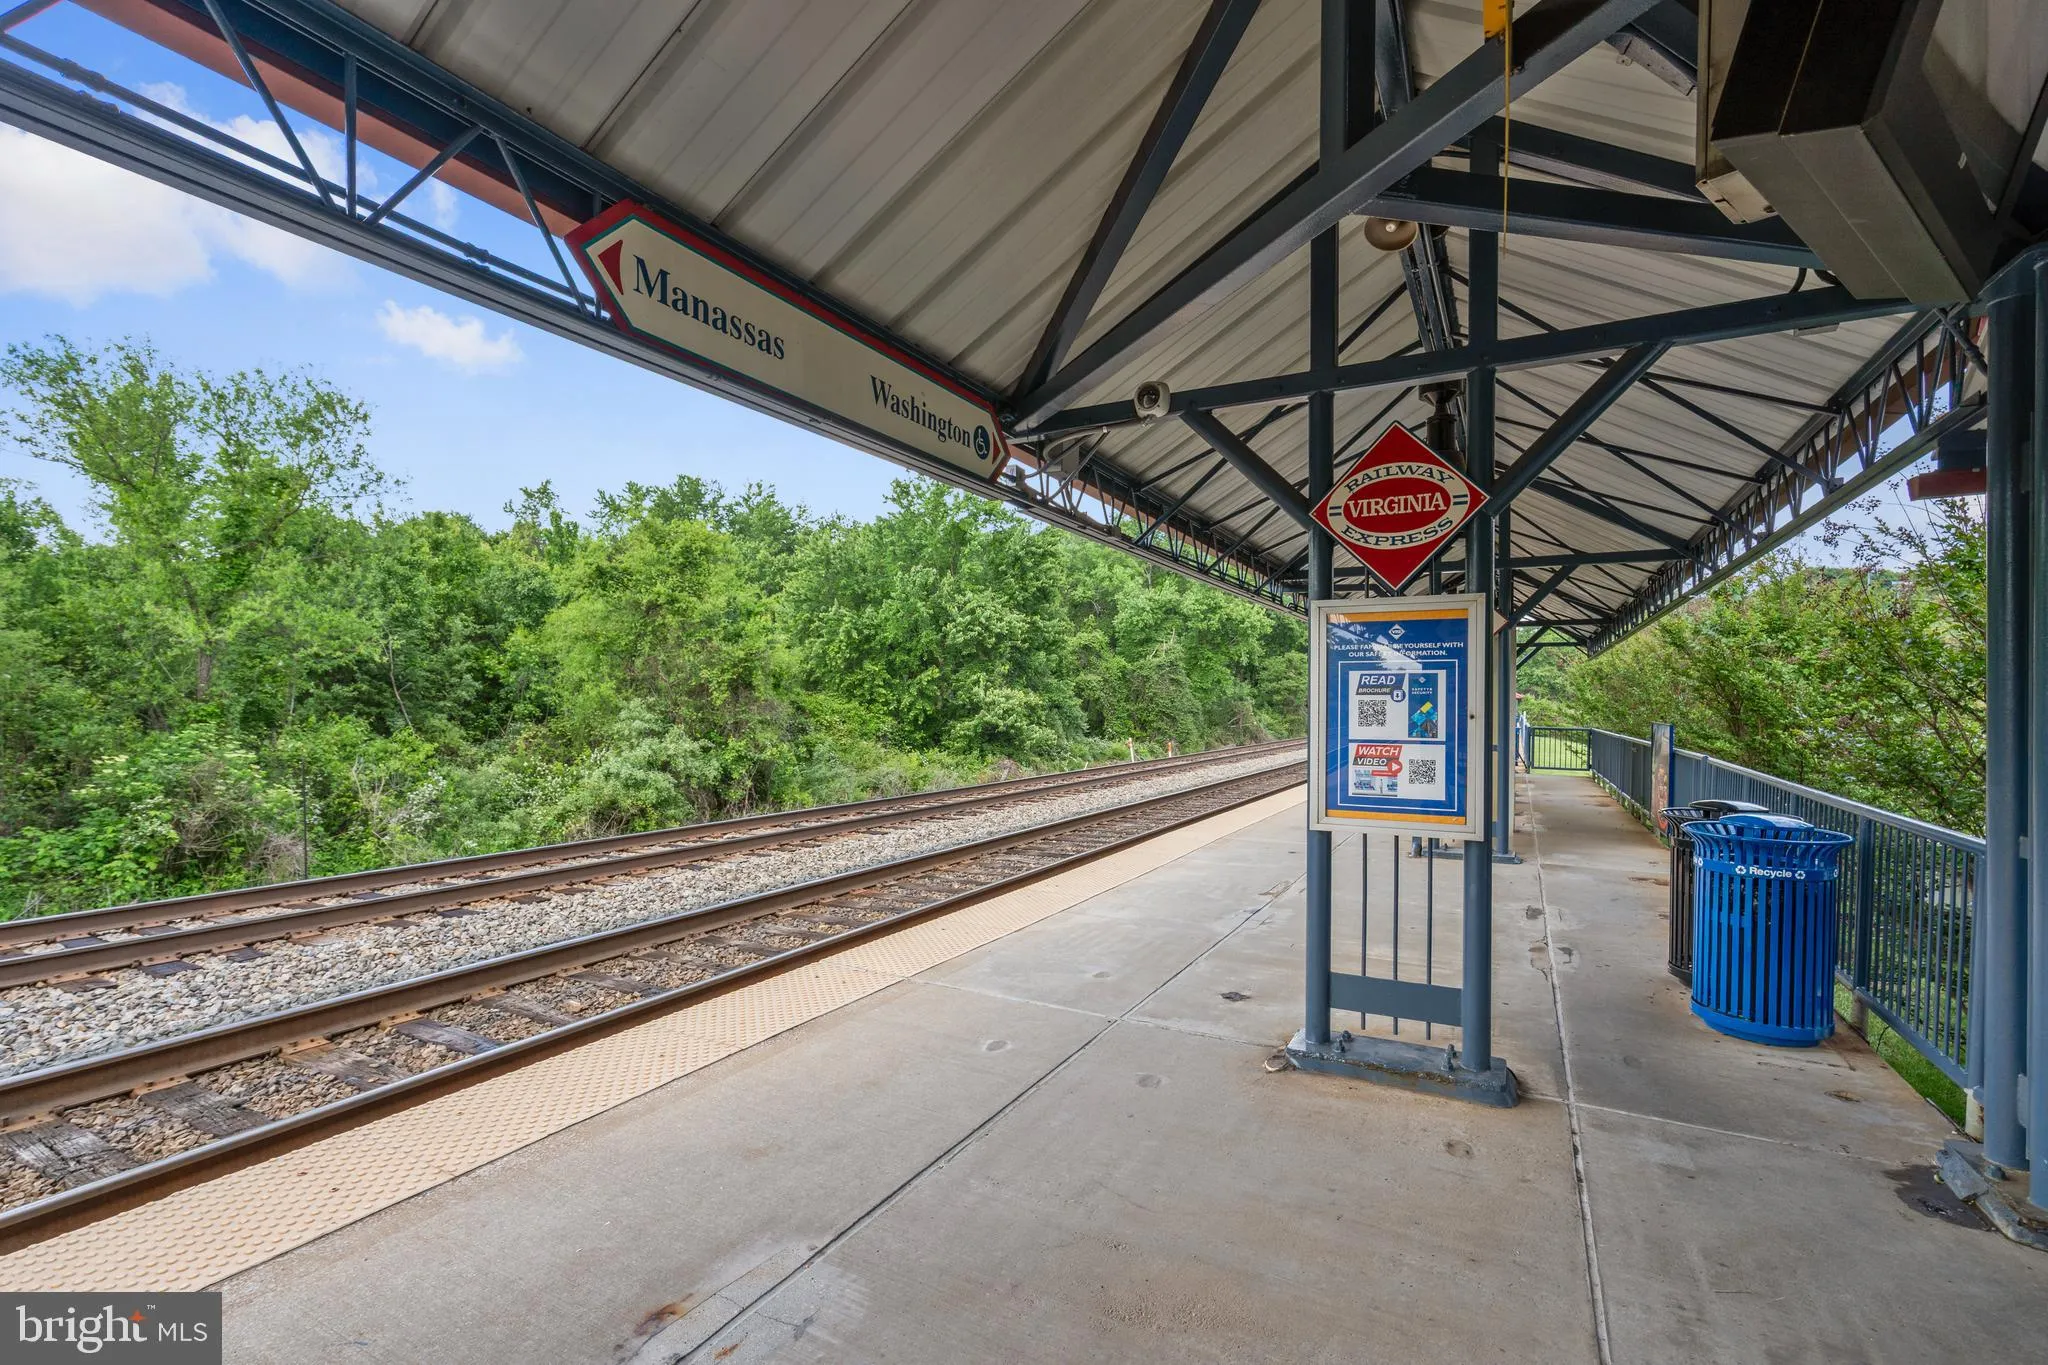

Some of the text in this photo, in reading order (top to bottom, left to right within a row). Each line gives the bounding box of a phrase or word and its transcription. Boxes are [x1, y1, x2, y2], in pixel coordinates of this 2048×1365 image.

[633, 254, 785, 361] Manassas
[870, 375, 971, 449] Washington
[1344, 465, 1455, 493] RAILWAY
[1347, 492, 1447, 518] VIRGINIA
[1341, 517, 1453, 546] EXPRESS
[1348, 650, 1364, 658] OUR
[1361, 675, 1396, 685] READ
[1359, 746, 1400, 756] WATCH
[1357, 757, 1387, 766] VIDEO
[1749, 866, 1793, 879] Recycle
